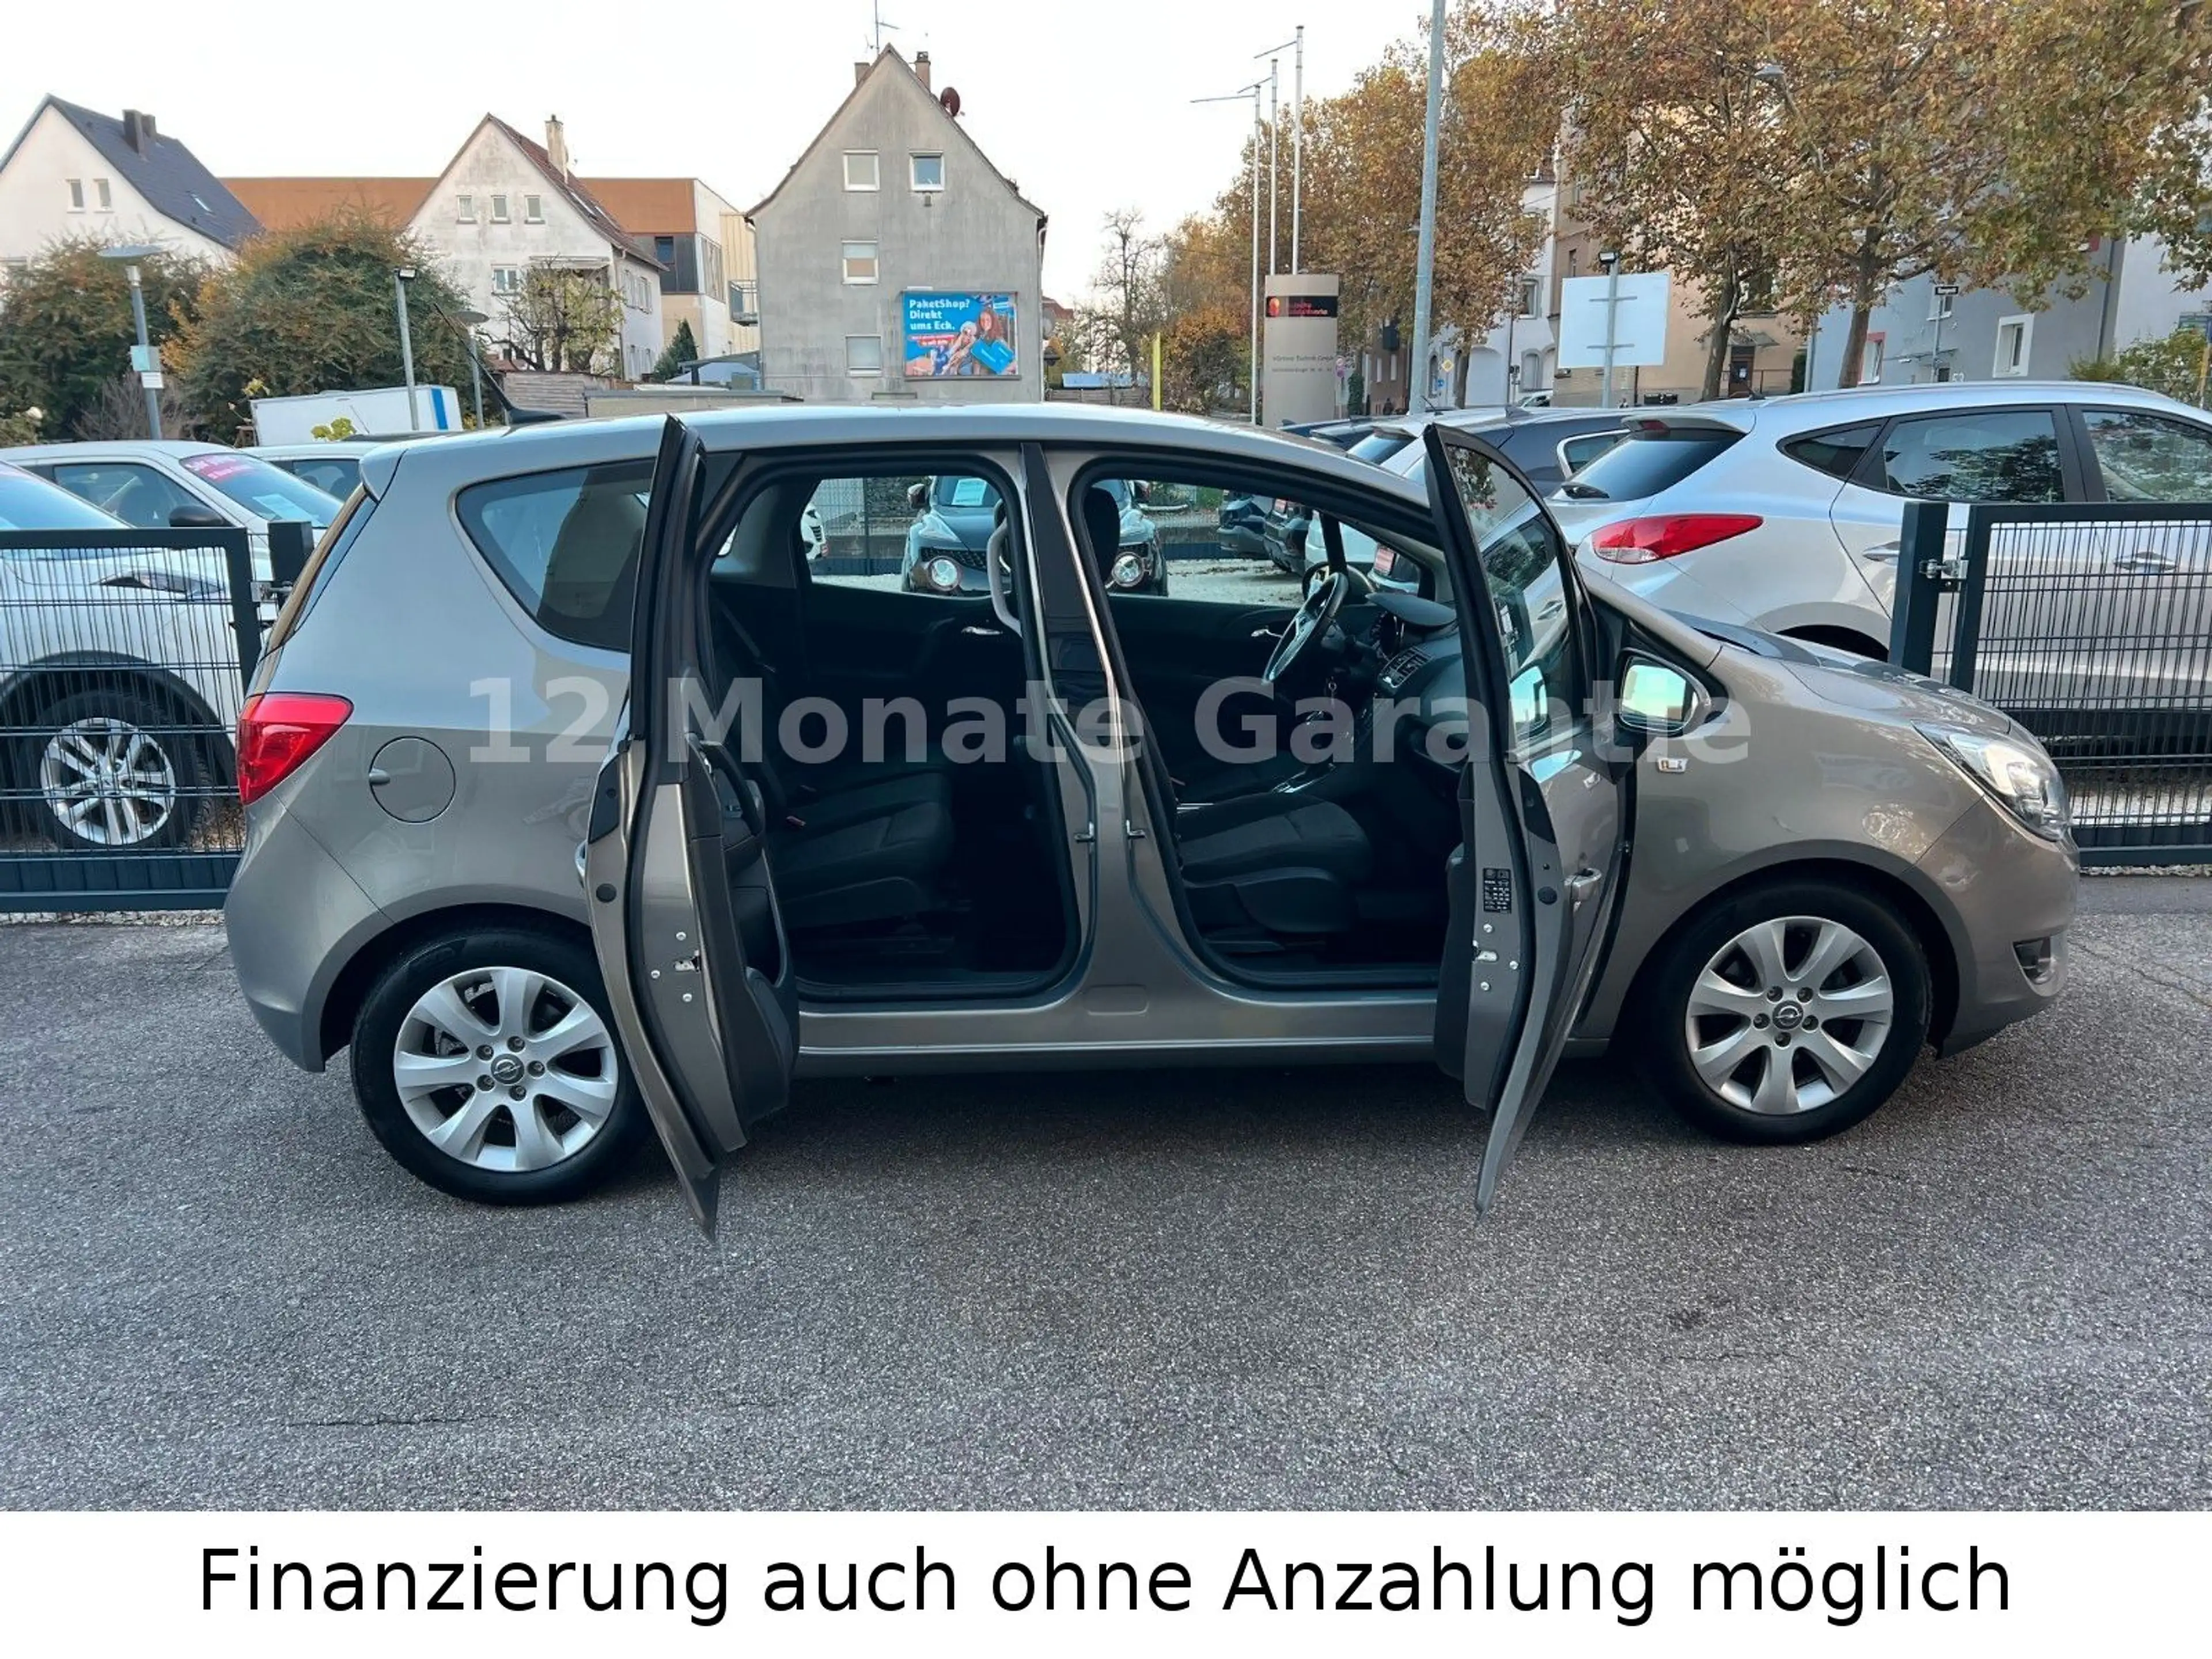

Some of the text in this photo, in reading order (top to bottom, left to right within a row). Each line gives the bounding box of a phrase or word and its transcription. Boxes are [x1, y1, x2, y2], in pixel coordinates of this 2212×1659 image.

[910, 299, 970, 310] PaketShop?
[910, 310, 942, 319] Direkt
[934, 321, 955, 330] Eck.
